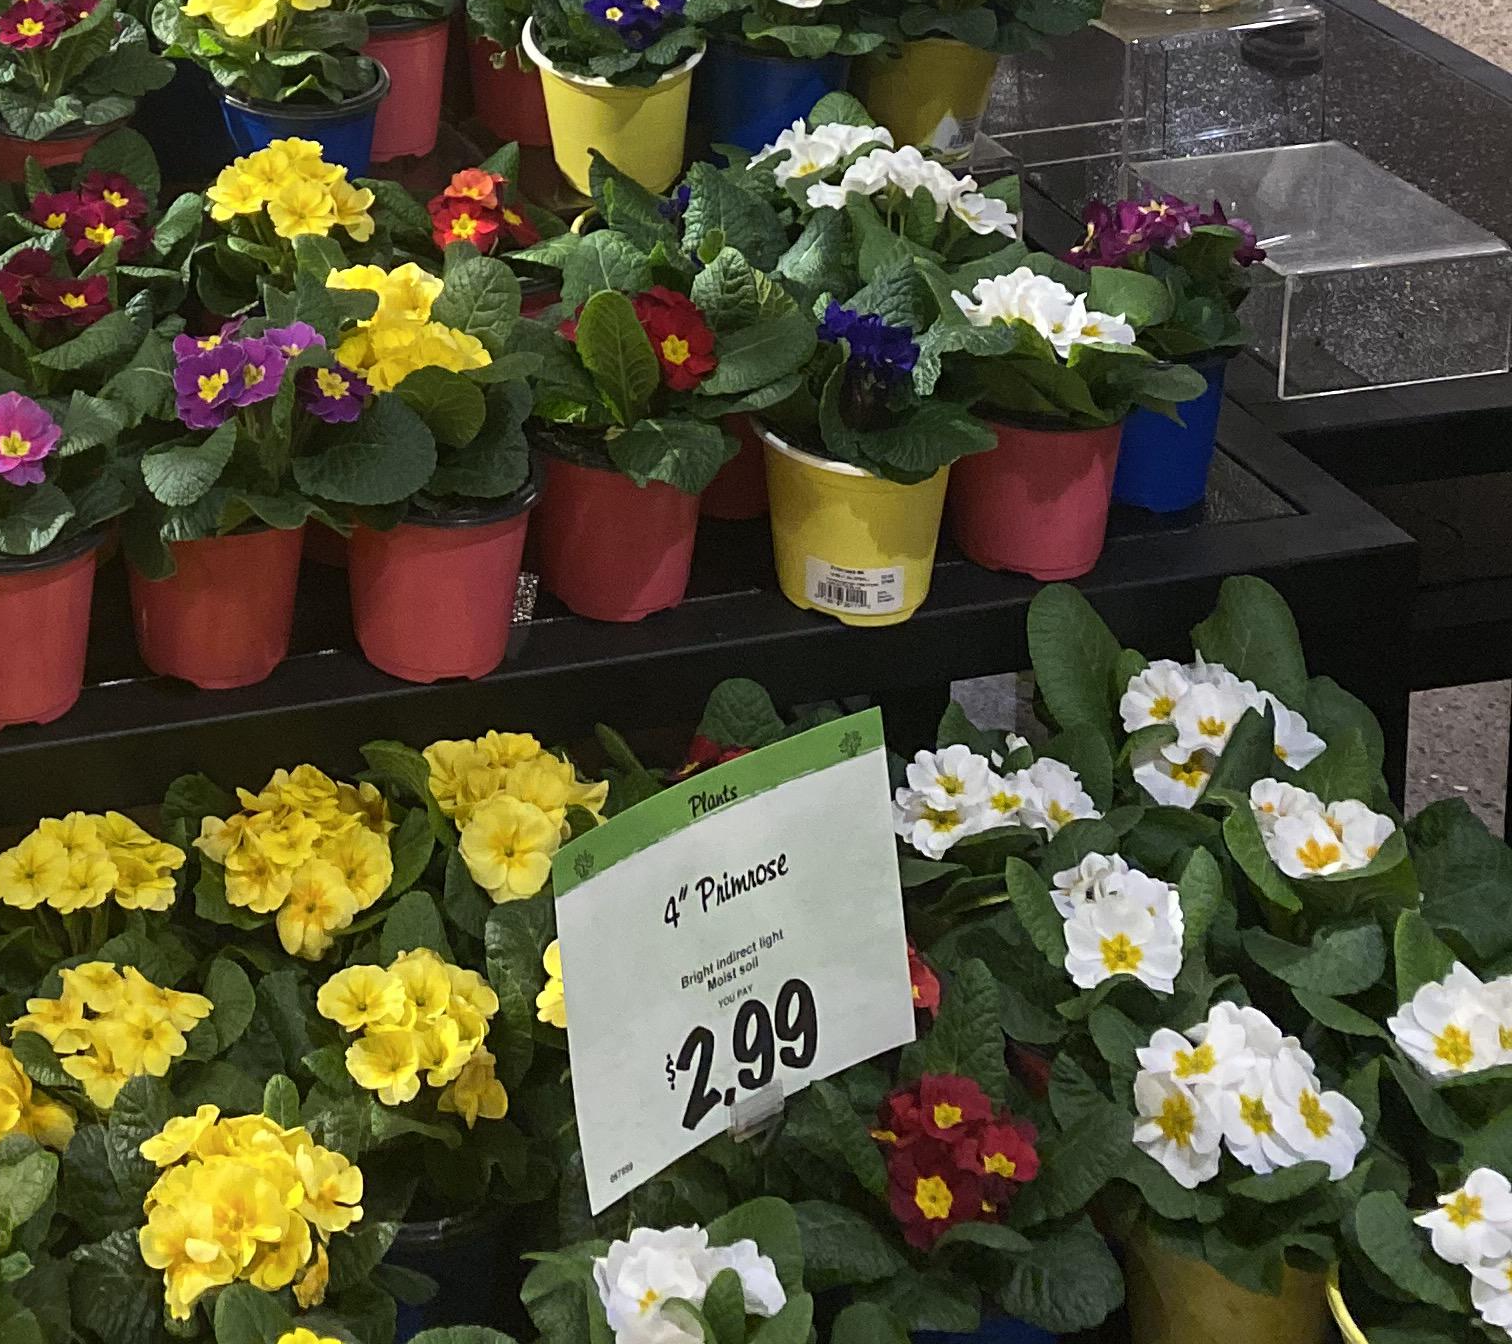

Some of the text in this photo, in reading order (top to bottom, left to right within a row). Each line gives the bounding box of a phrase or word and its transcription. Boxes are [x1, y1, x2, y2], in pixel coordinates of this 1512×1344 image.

[688, 784, 738, 818] Plants
[664, 852, 789, 928] 4" Primrose
[680, 928, 785, 989] Bright indirect light
[707, 955, 759, 992] Moist soil
[718, 983, 753, 1009] YOU PAY
[666, 978, 818, 1131] $2.99
